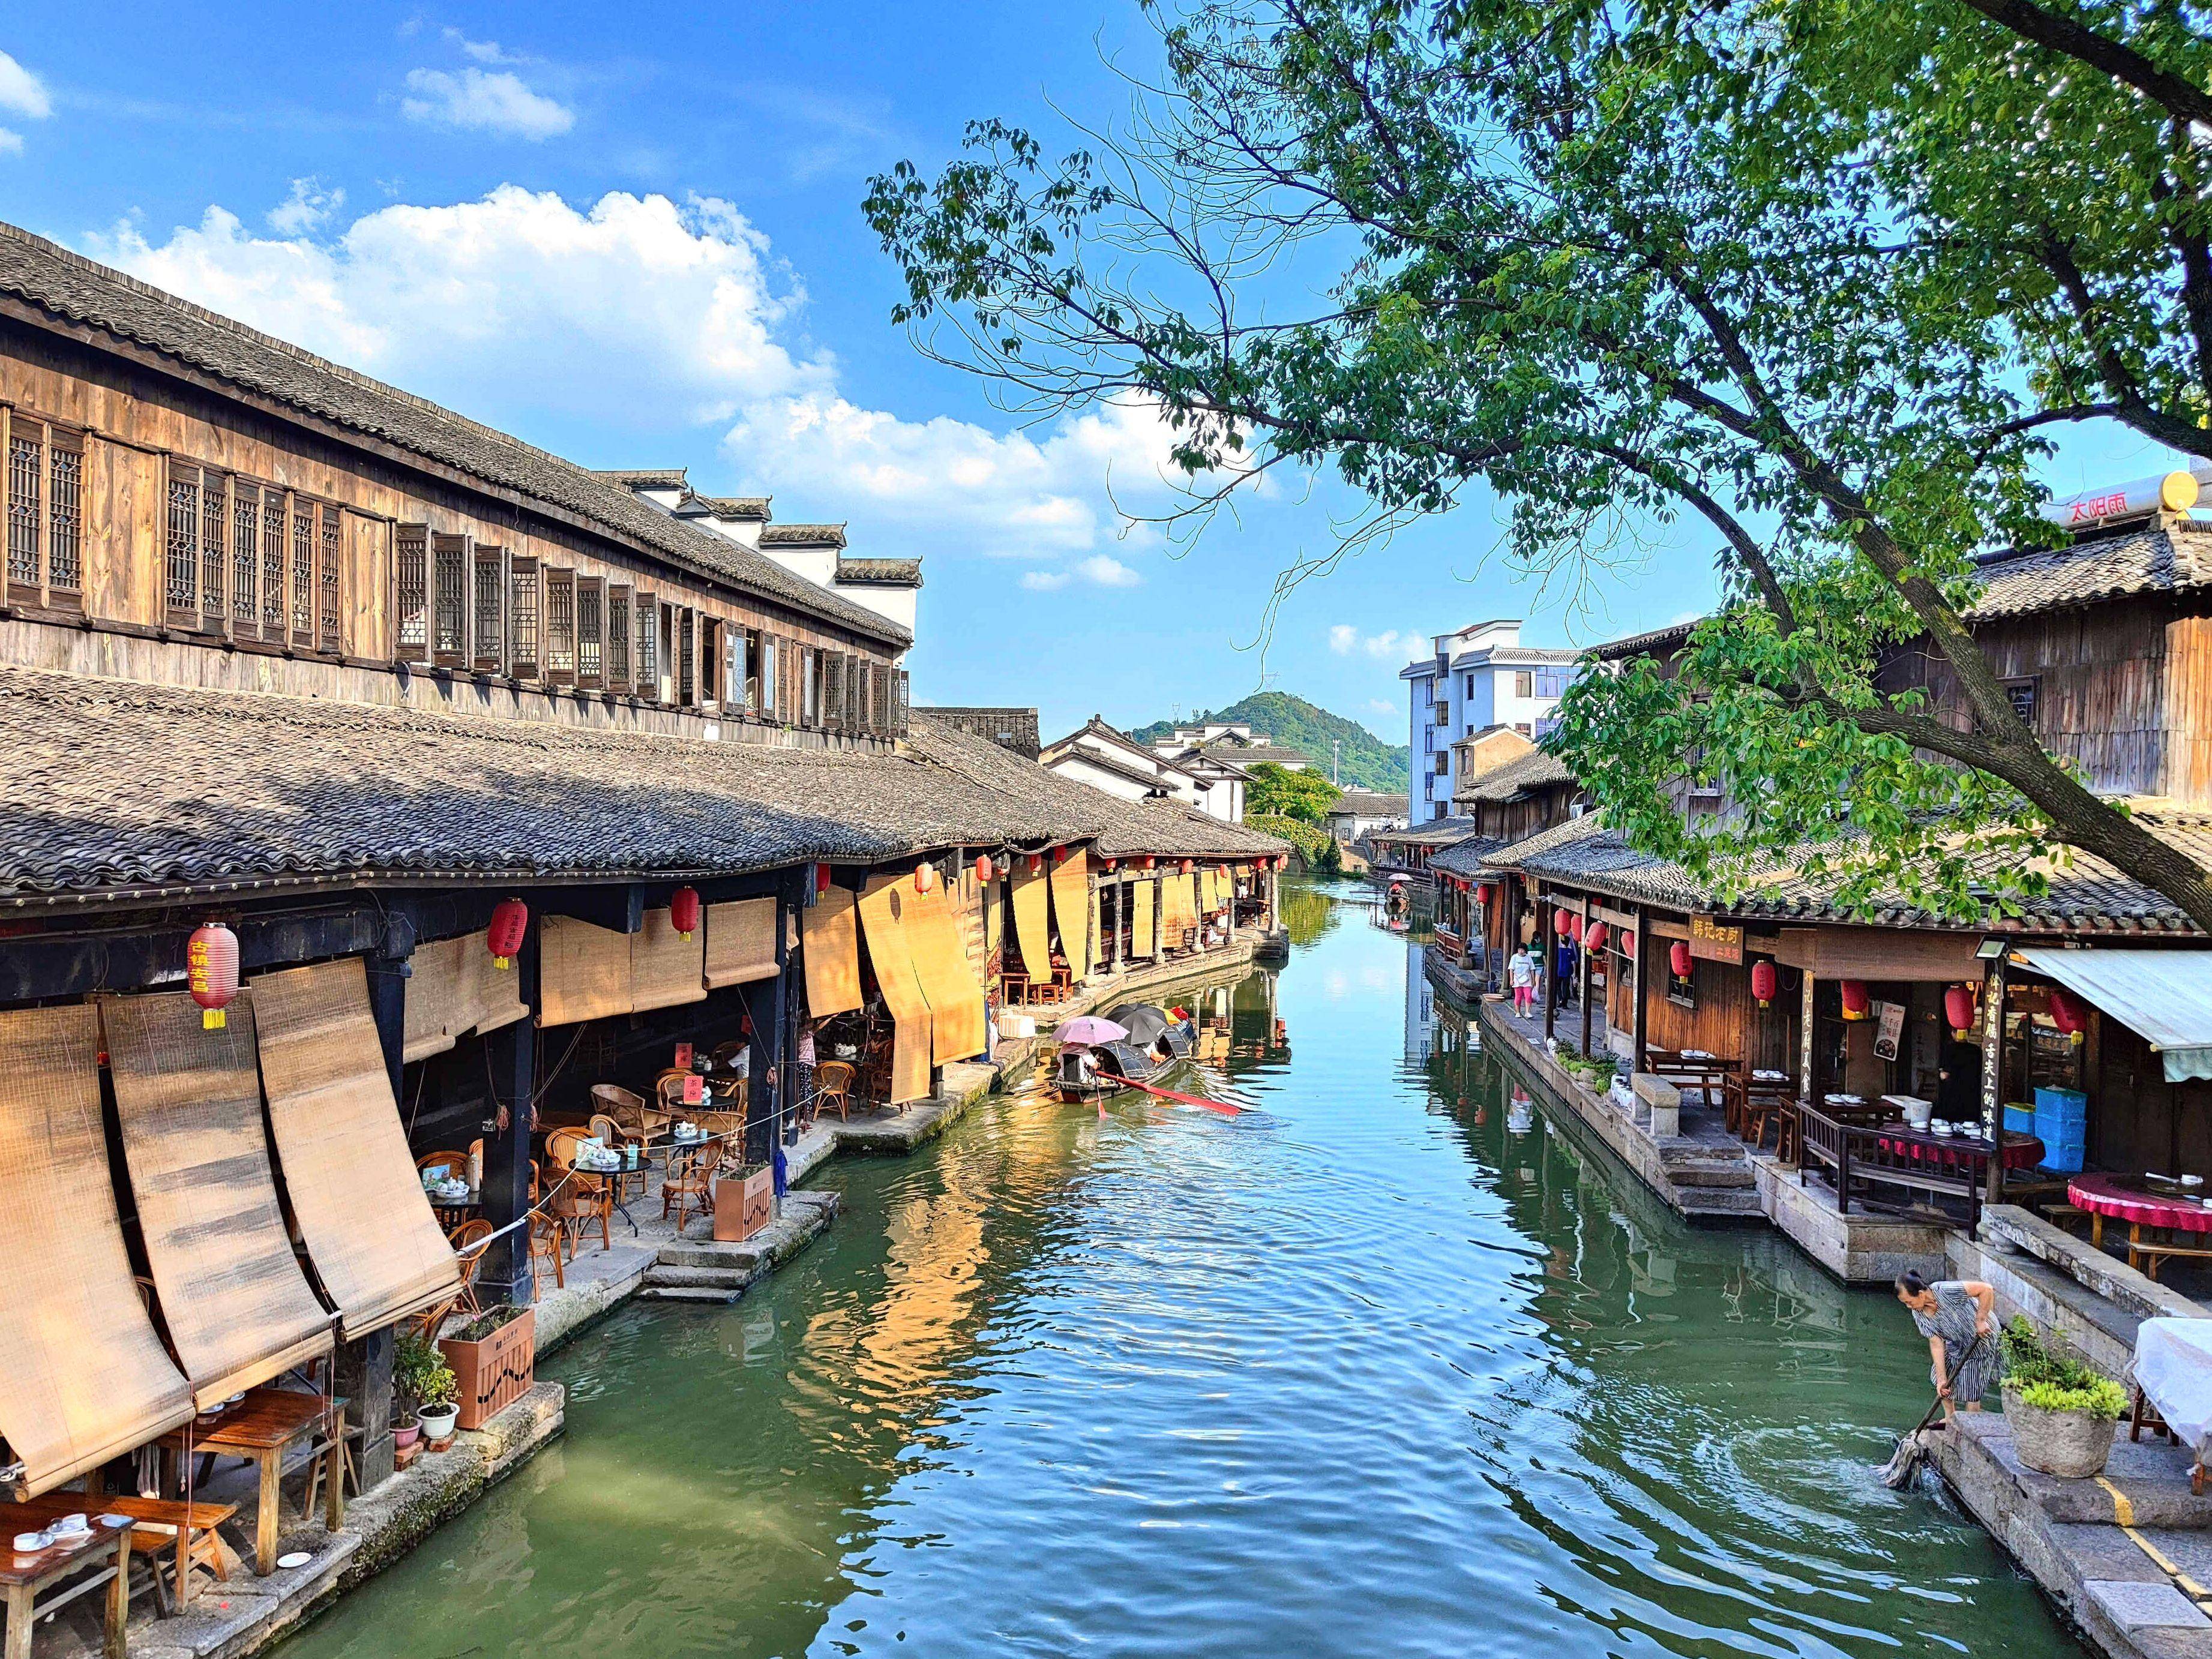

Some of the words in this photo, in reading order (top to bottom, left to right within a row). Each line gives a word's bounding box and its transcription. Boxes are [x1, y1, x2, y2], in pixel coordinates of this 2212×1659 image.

[2070, 491, 2127, 522] 太阳雨
[190, 941, 211, 992] 古镇安昌
